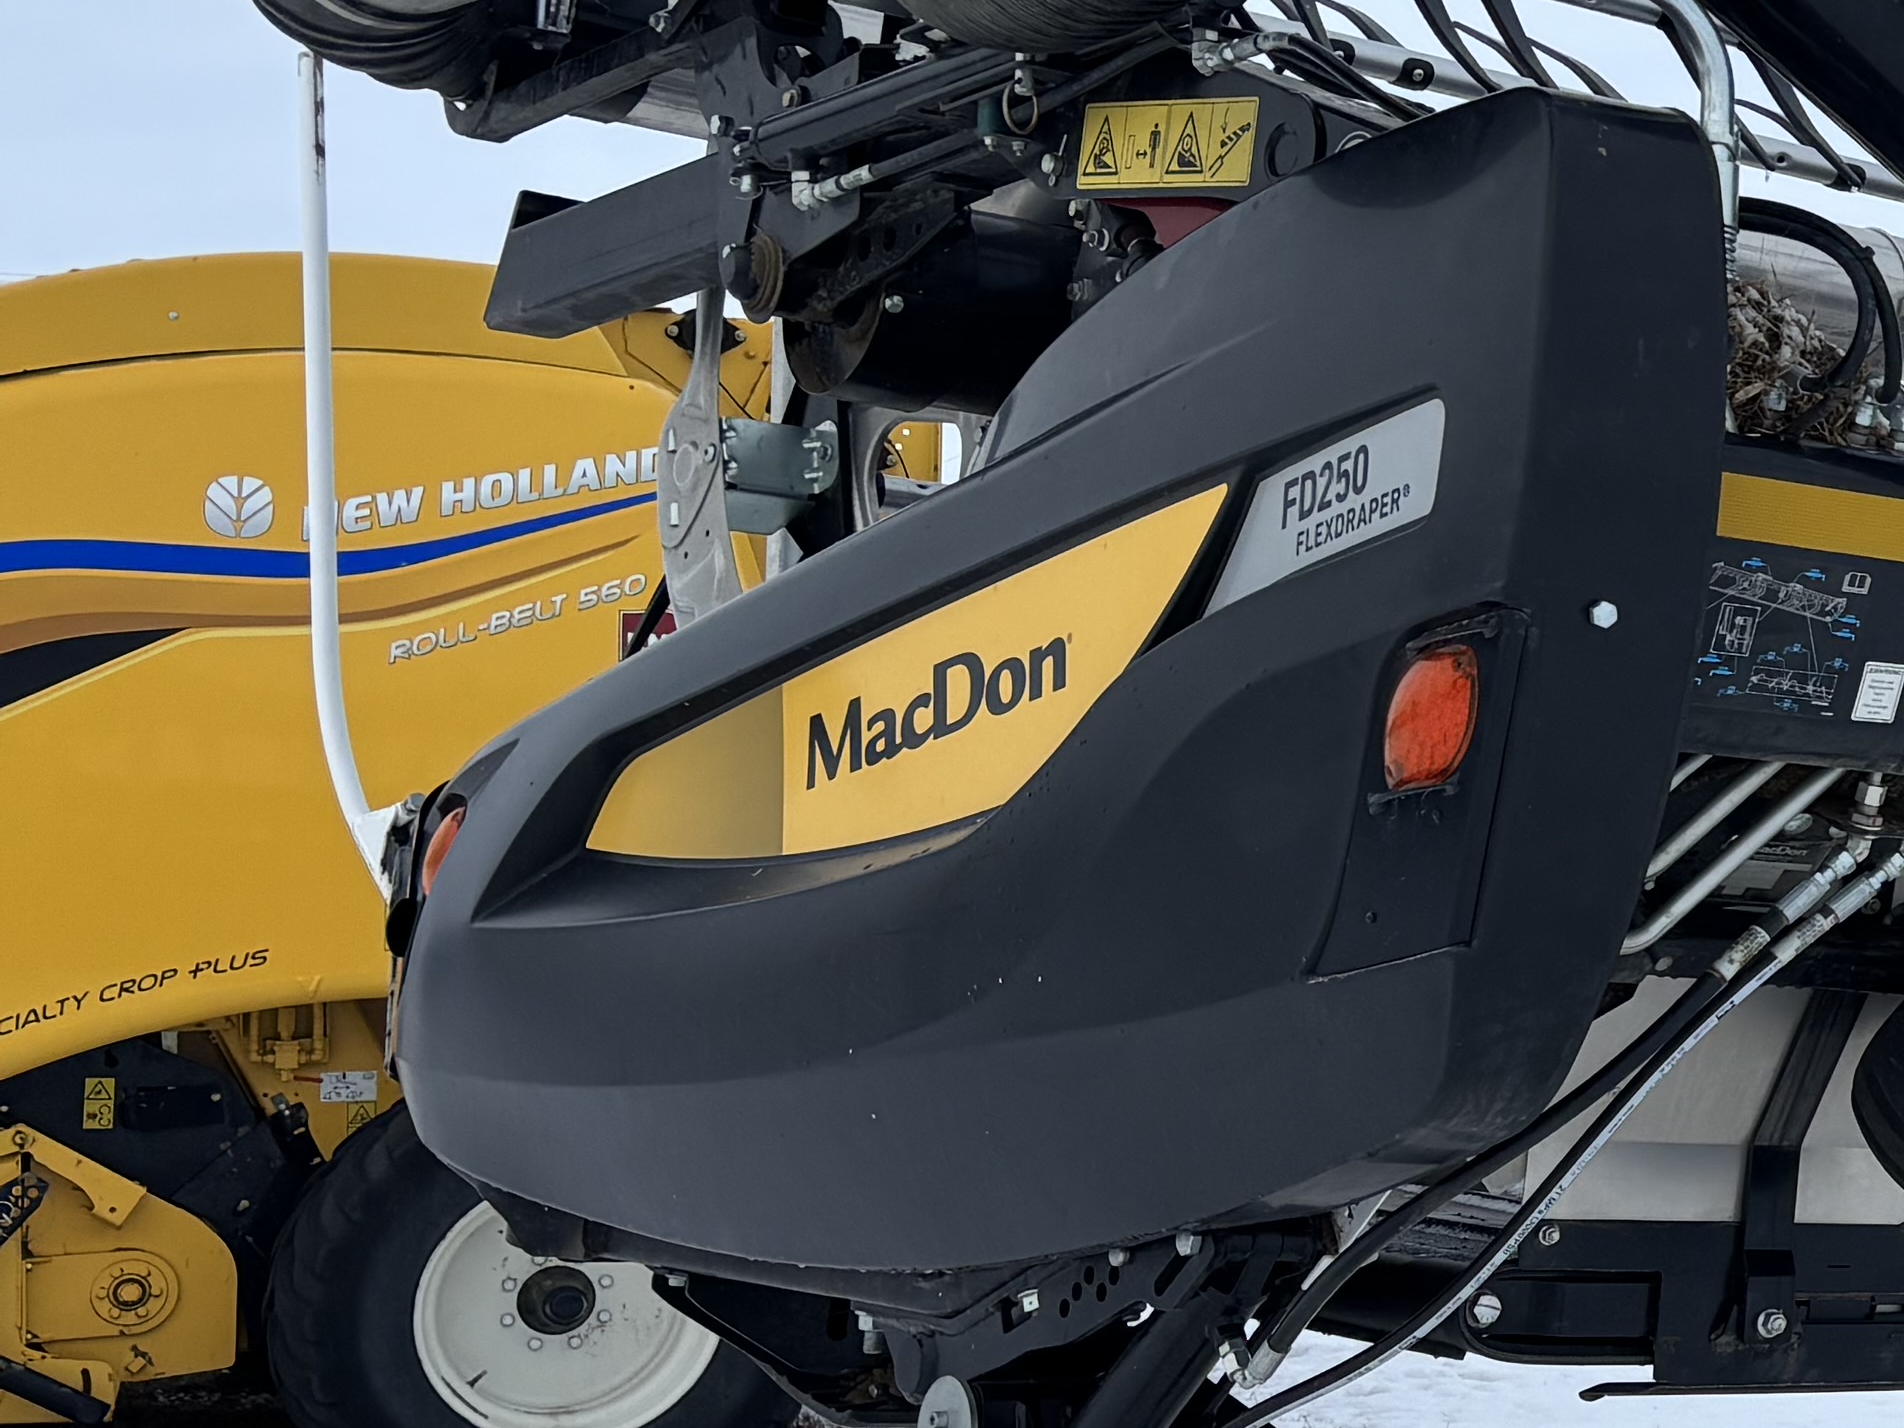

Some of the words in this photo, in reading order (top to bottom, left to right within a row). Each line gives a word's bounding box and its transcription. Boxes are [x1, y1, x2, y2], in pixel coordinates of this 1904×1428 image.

[1281, 444, 1369, 530] FD250
[387, 594, 567, 664] ROLL-BELT
[577, 573, 647, 612] 560
[98, 968, 178, 1003] CROP
